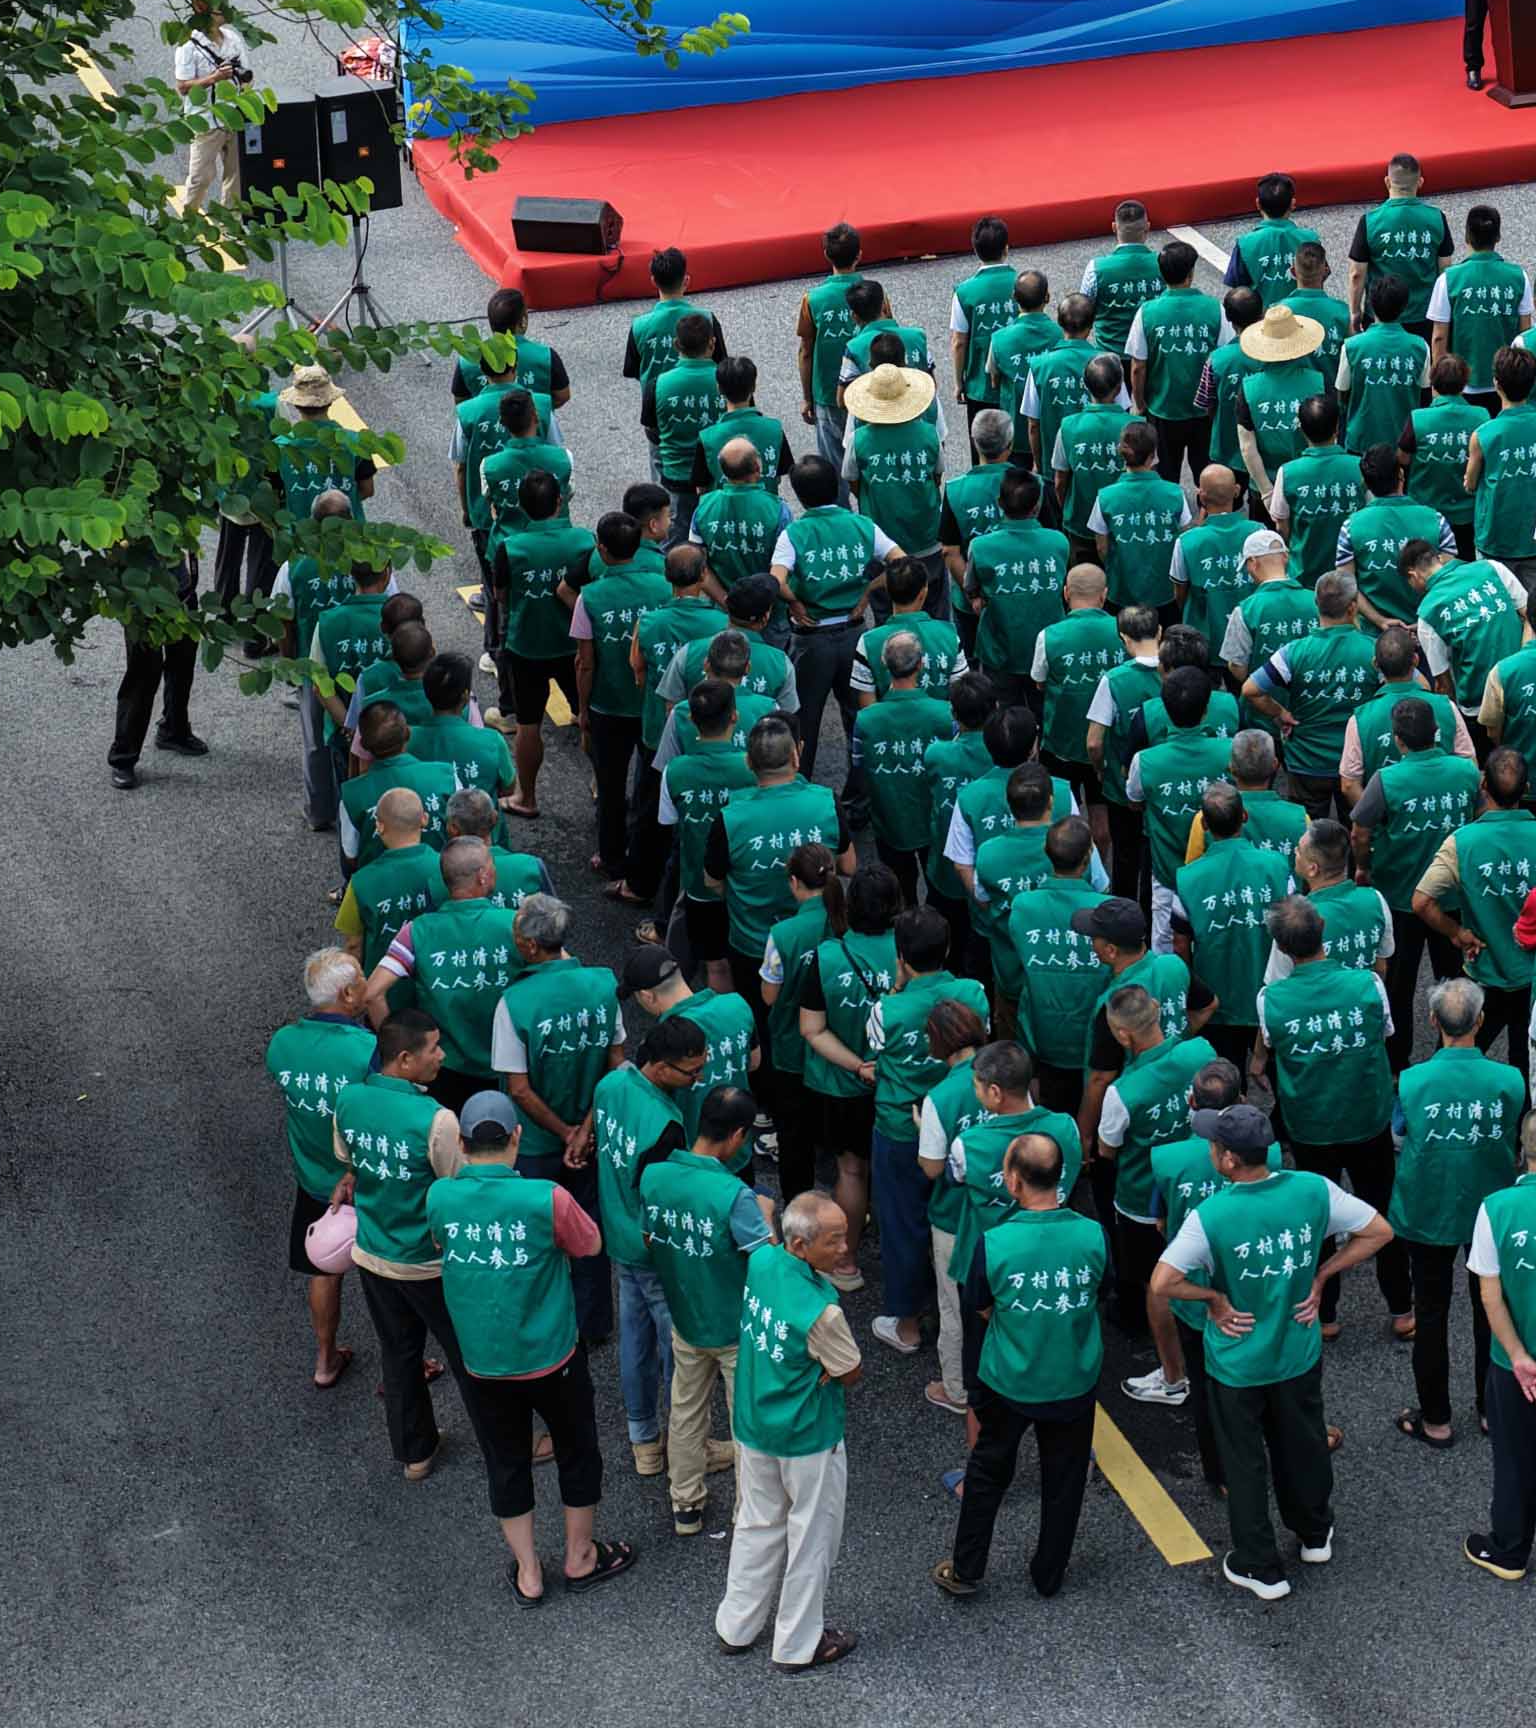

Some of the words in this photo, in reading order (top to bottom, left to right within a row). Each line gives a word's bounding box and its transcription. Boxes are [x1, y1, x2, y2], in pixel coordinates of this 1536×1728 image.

[1379, 229, 1432, 245] 万村清洁
[1381, 245, 1431, 261] 人人参与
[1461, 284, 1515, 301] 万村清洁
[1461, 301, 1513, 317] 人人参与
[1154, 323, 1209, 339] 万村清洁
[1158, 341, 1213, 359] 人人参与
[1360, 355, 1415, 371] 万村清洁
[867, 449, 928, 467] 万村清洁
[869, 468, 928, 485] 人人参与
[1296, 481, 1358, 499] 万村清洁
[1111, 509, 1174, 527] 万村清洁
[1297, 500, 1361, 517] 人人参与
[707, 519, 765, 538] 万村清洁
[804, 541, 865, 564] 万村清洁
[993, 556, 1057, 577] 万村清洁
[994, 577, 1059, 595] 人人参与
[1303, 665, 1367, 684] 万村清洁
[1299, 685, 1363, 704] 人人参与
[1403, 789, 1469, 813] 万村清洁
[1201, 883, 1273, 911] 万村清洁
[429, 944, 509, 968] 万村清洁
[430, 969, 509, 992] 人人参与
[536, 1004, 607, 1037] 万村清洁
[1284, 1006, 1364, 1035] 万村清洁
[541, 1030, 609, 1054] 人人参与
[1289, 1031, 1367, 1056] 人人参与
[1423, 1098, 1504, 1121] 万村清洁
[340, 1128, 410, 1161] 万村清洁
[1424, 1123, 1504, 1145] 人人参与
[443, 1220, 527, 1244] 万村清洁
[646, 1204, 715, 1238] 万村清洁
[1233, 1222, 1313, 1260] 万村清洁
[447, 1245, 529, 1270] 人人参与
[1239, 1249, 1313, 1281] 人人参与
[1007, 1264, 1093, 1291] 万村清洁
[1010, 1290, 1089, 1314] 人人参与
